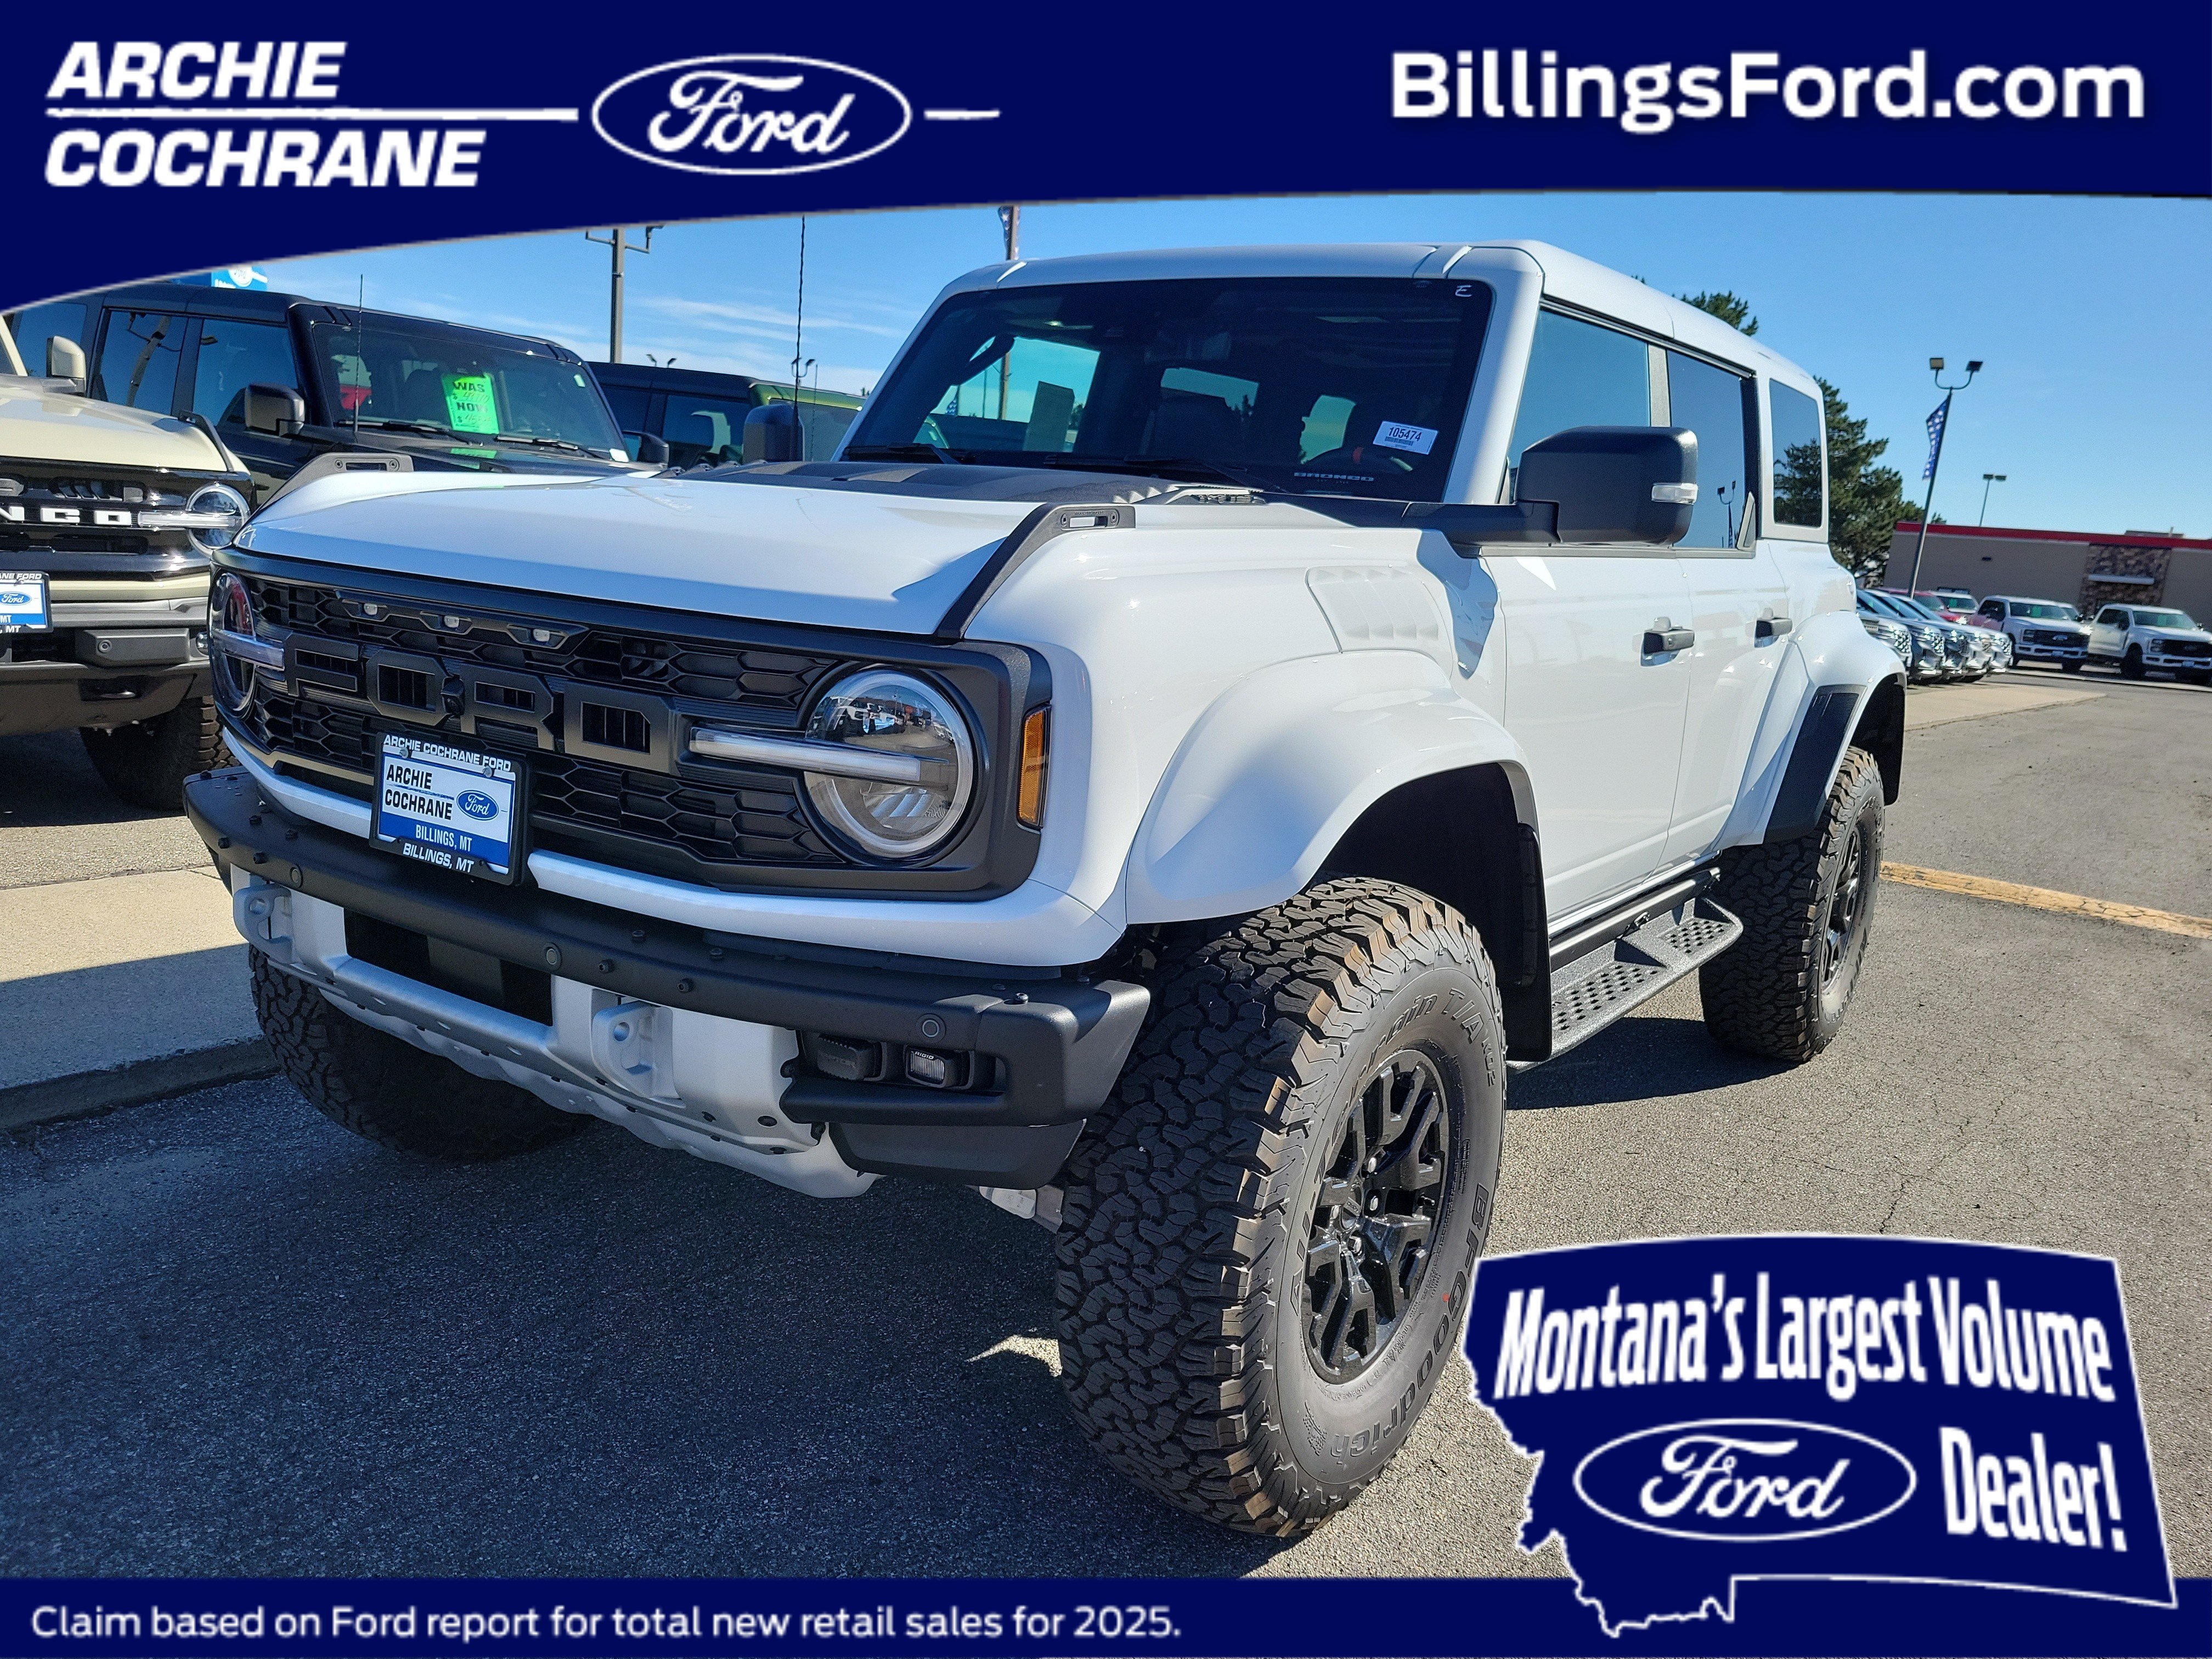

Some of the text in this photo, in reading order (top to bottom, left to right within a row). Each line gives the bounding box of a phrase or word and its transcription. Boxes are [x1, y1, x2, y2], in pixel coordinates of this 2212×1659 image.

[453, 382, 485, 392] WAS
[1389, 427, 1422, 442] 105474
[1, 594, 24, 603] Ford
[286, 631, 674, 774] FORD
[383, 734, 511, 772] ARCHIE COCHRANE FORD
[386, 764, 432, 790] ARCHIE
[385, 788, 453, 821] COCHRANE
[465, 794, 490, 816] Ford
[415, 825, 472, 852] BILLINGS, MT
[403, 843, 475, 873] BILLINGS, MT
[915, 1051, 934, 1060] RIGID
